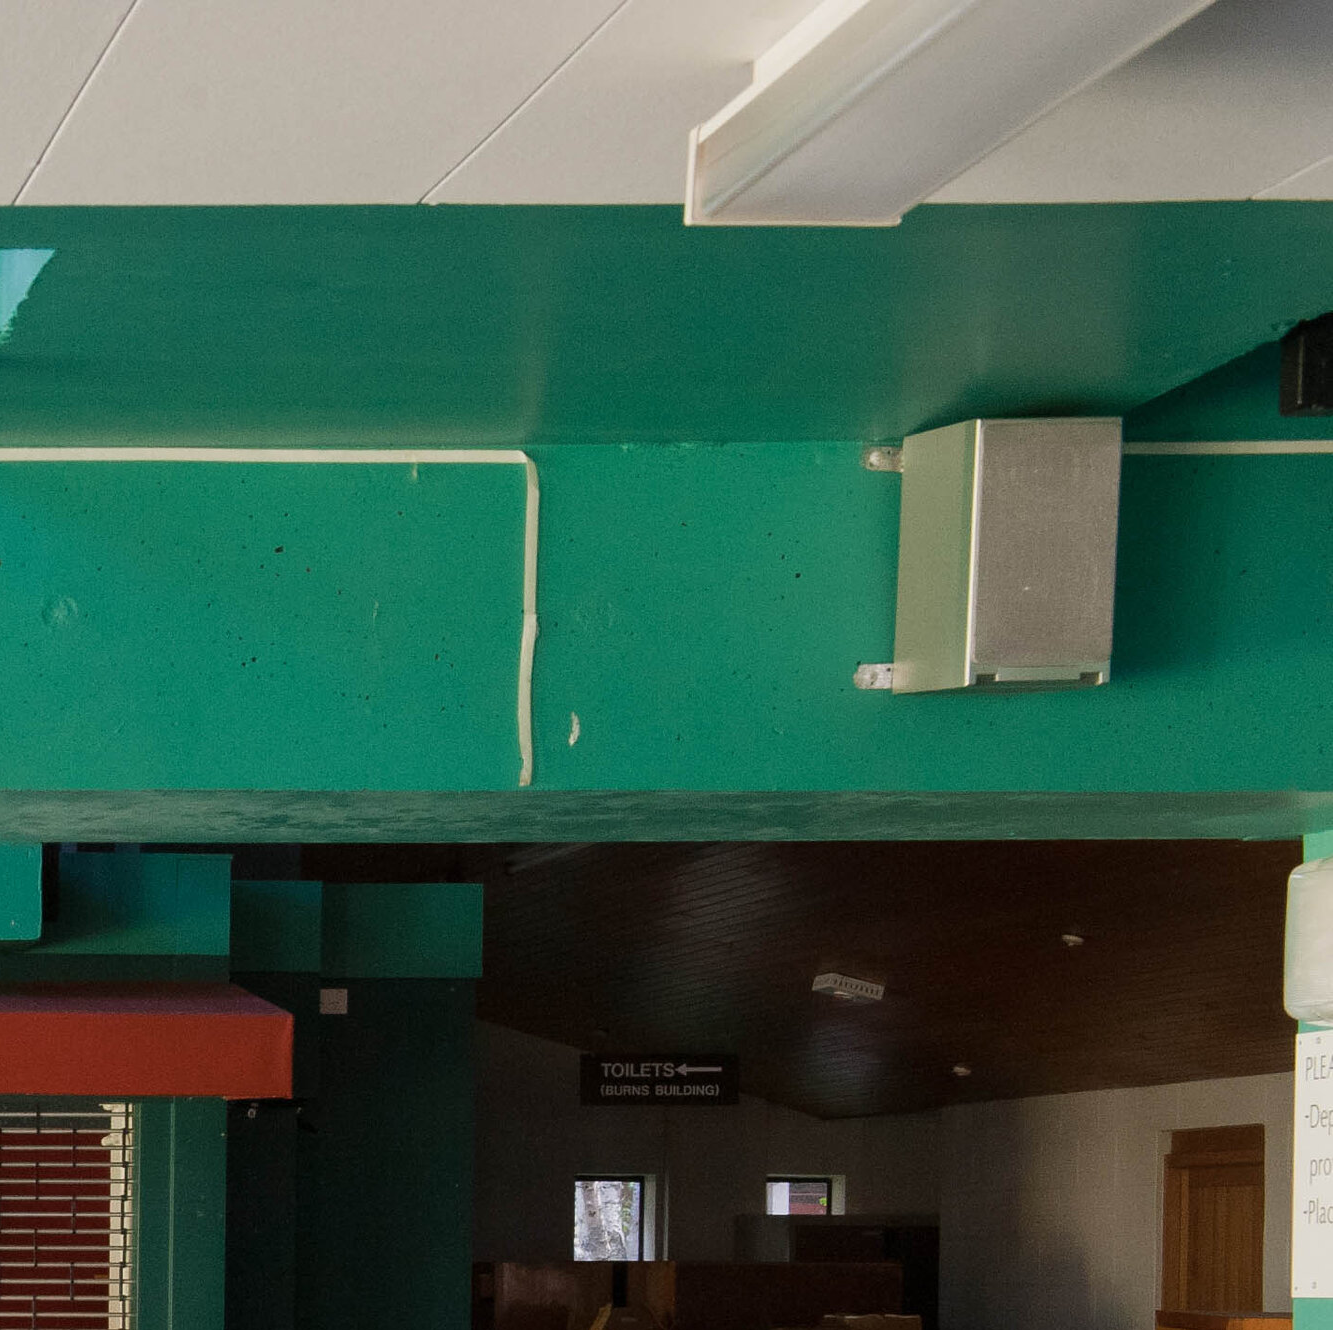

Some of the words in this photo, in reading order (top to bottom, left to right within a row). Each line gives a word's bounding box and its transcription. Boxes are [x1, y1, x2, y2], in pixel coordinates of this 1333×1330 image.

[600, 1062, 676, 1078] TOILETS
[600, 1084, 650, 1097] (BURNS
[654, 1084, 720, 1097] BUILDING)
